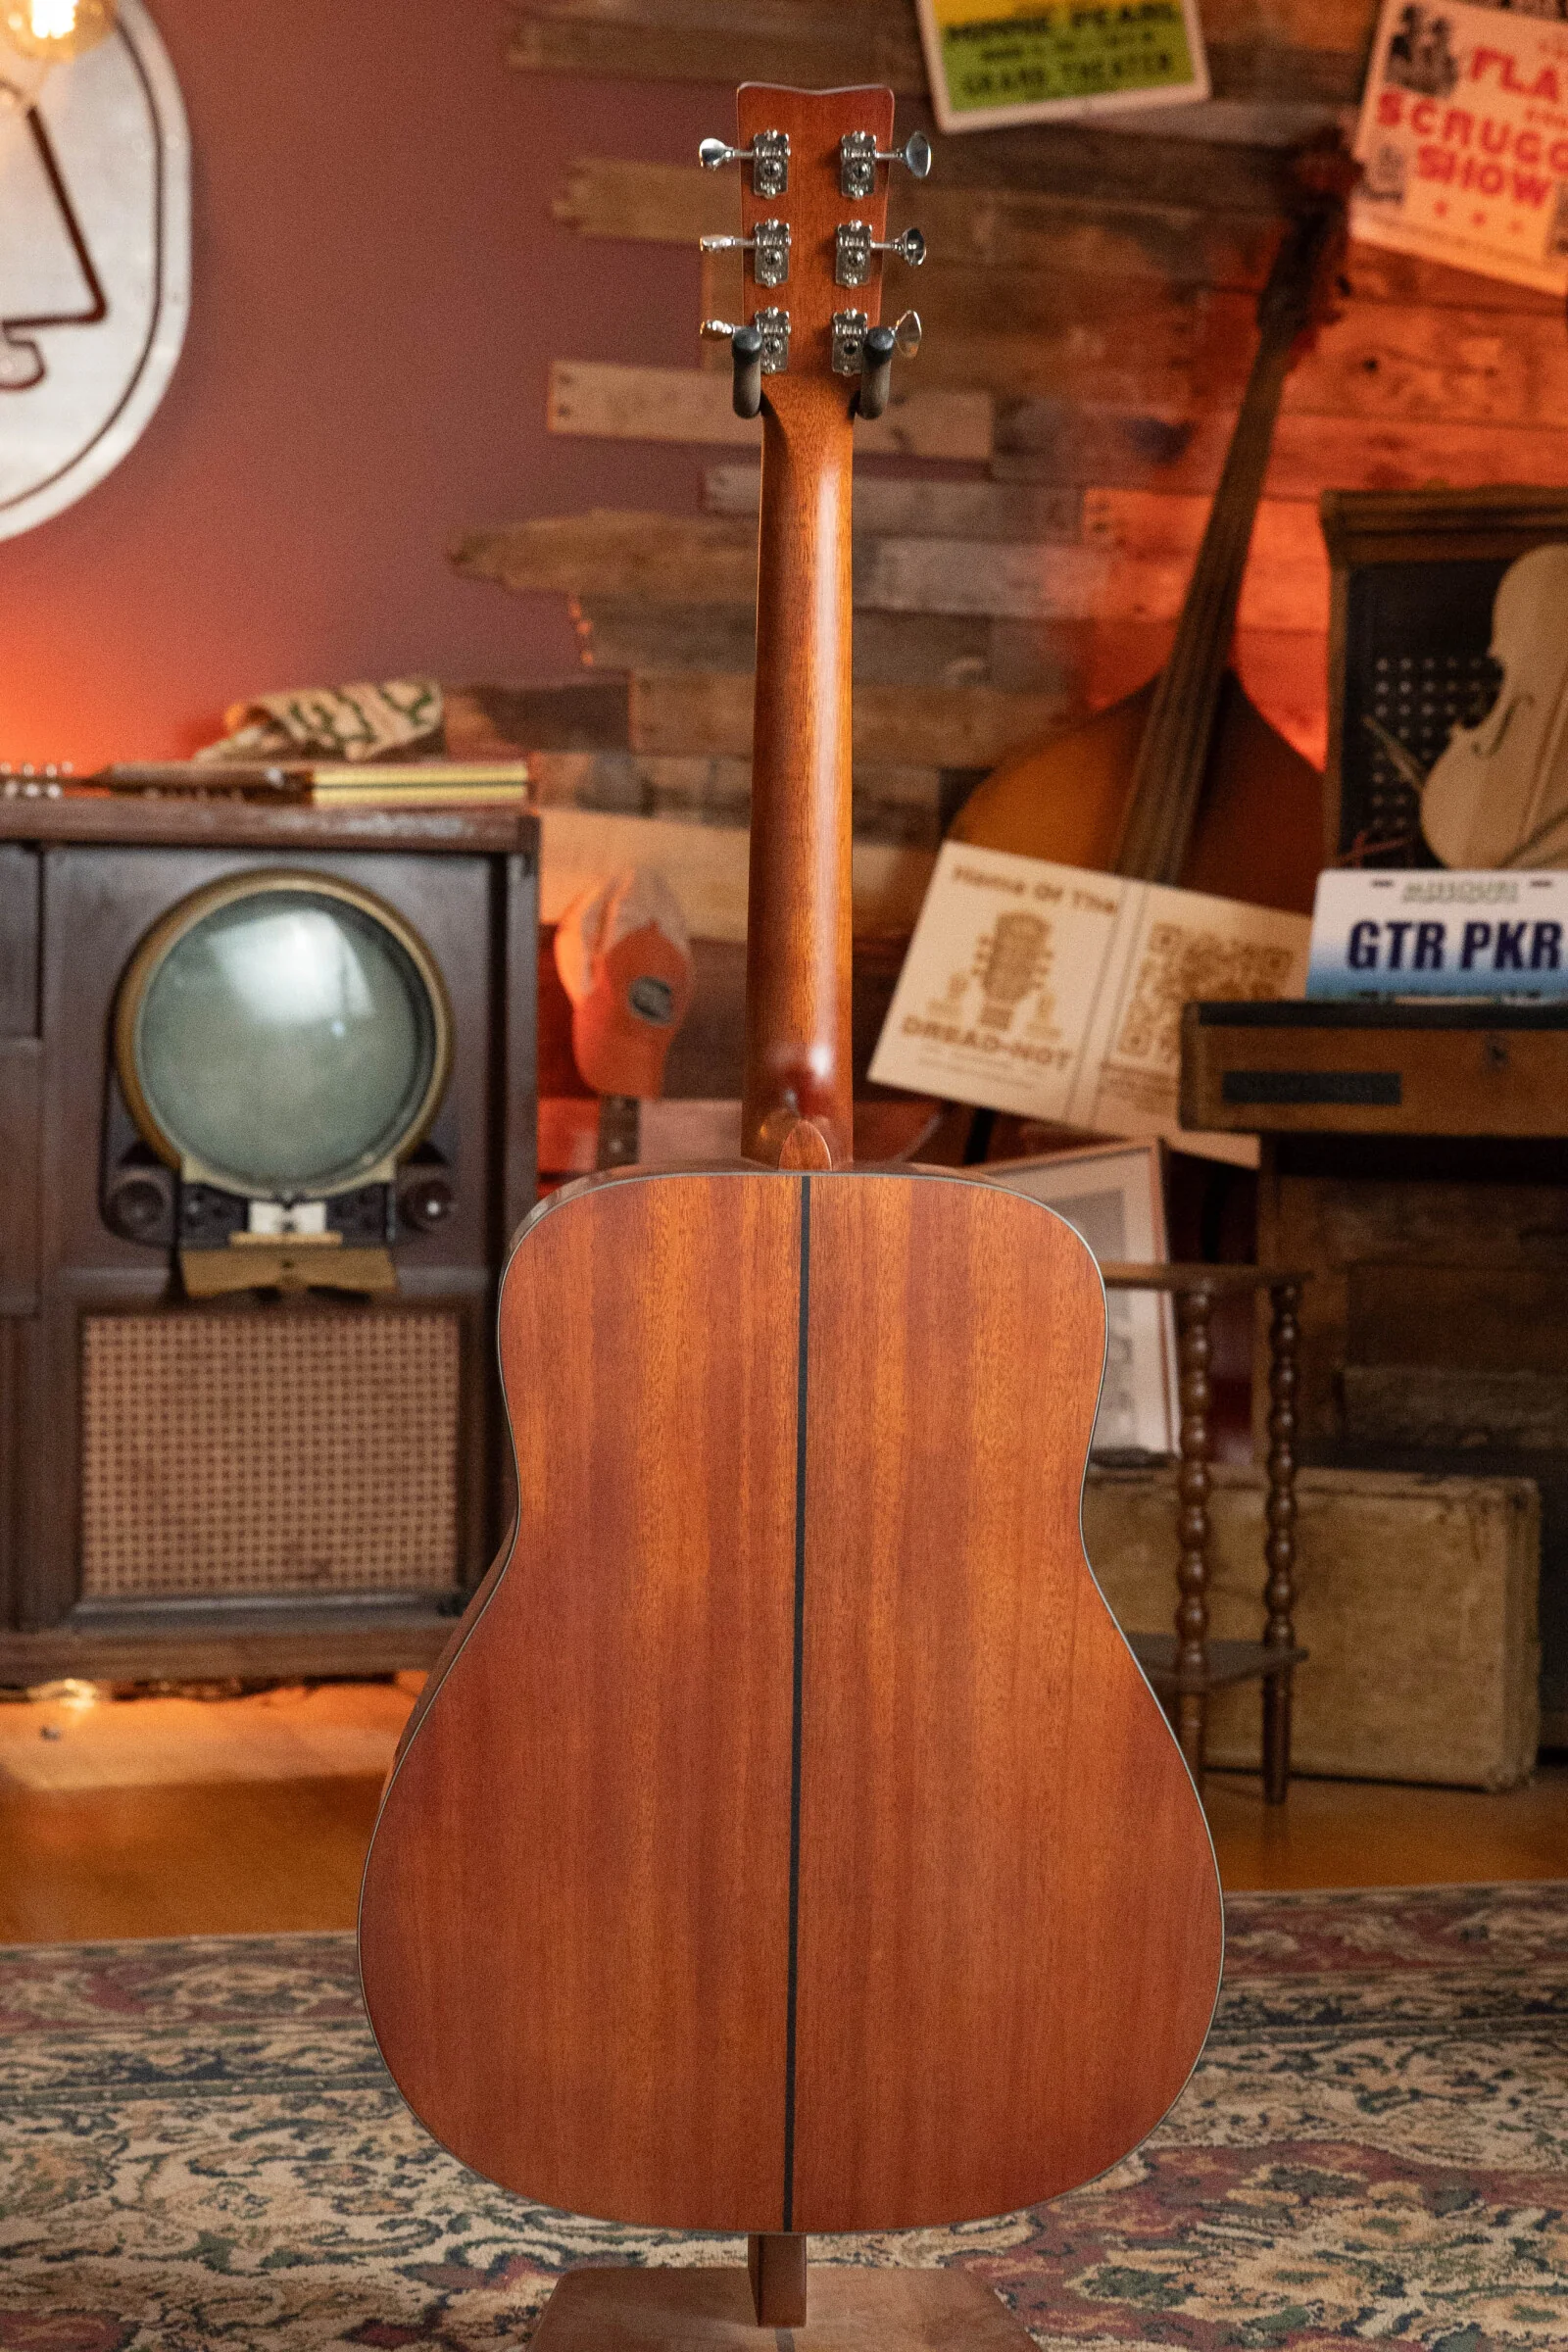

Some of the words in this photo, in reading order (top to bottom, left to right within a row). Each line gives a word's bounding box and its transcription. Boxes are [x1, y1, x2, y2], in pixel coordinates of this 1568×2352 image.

[1417, 144, 1552, 210] SHOW
[1348, 920, 1447, 970] GTR
[1459, 920, 1563, 970] PKR
